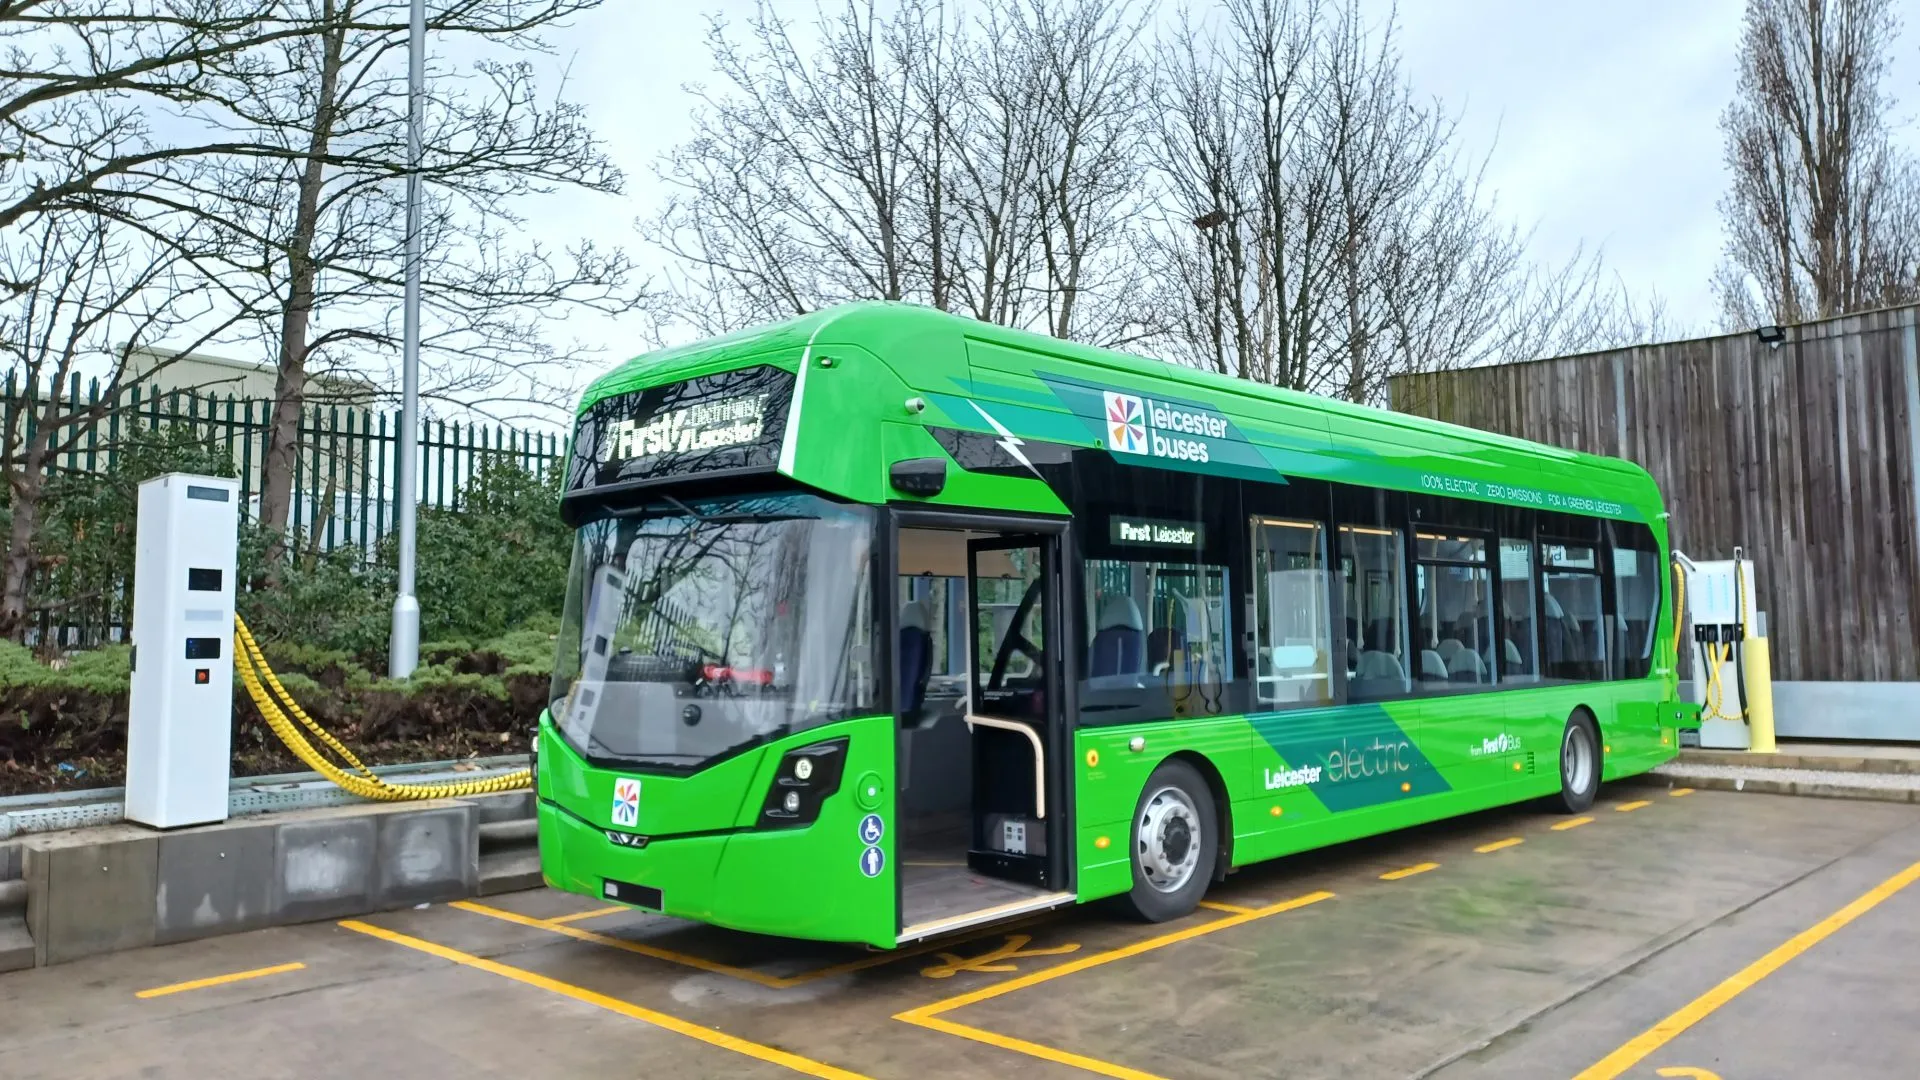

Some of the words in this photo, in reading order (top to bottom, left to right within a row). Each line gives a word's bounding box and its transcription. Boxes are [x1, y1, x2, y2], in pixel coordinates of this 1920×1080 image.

[618, 412, 672, 460] First
[689, 420, 758, 450] Leicester
[1147, 399, 1228, 438] leicester
[1152, 427, 1209, 463] buses
[1420, 474, 1444, 490] 100%
[1445, 477, 1480, 495] ELECTRIC
[1486, 484, 1506, 499] ZERO
[1507, 487, 1543, 505] EMISSIONS
[1548, 493, 1561, 506] FOR
[1562, 496, 1567, 506] A
[1567, 496, 1594, 512] GREENER
[1595, 501, 1622, 516] LEICESTER
[1119, 521, 1151, 542] First
[1153, 525, 1195, 544] Leicester
[1264, 763, 1322, 790] Leicester
[1327, 736, 1409, 782] electric
